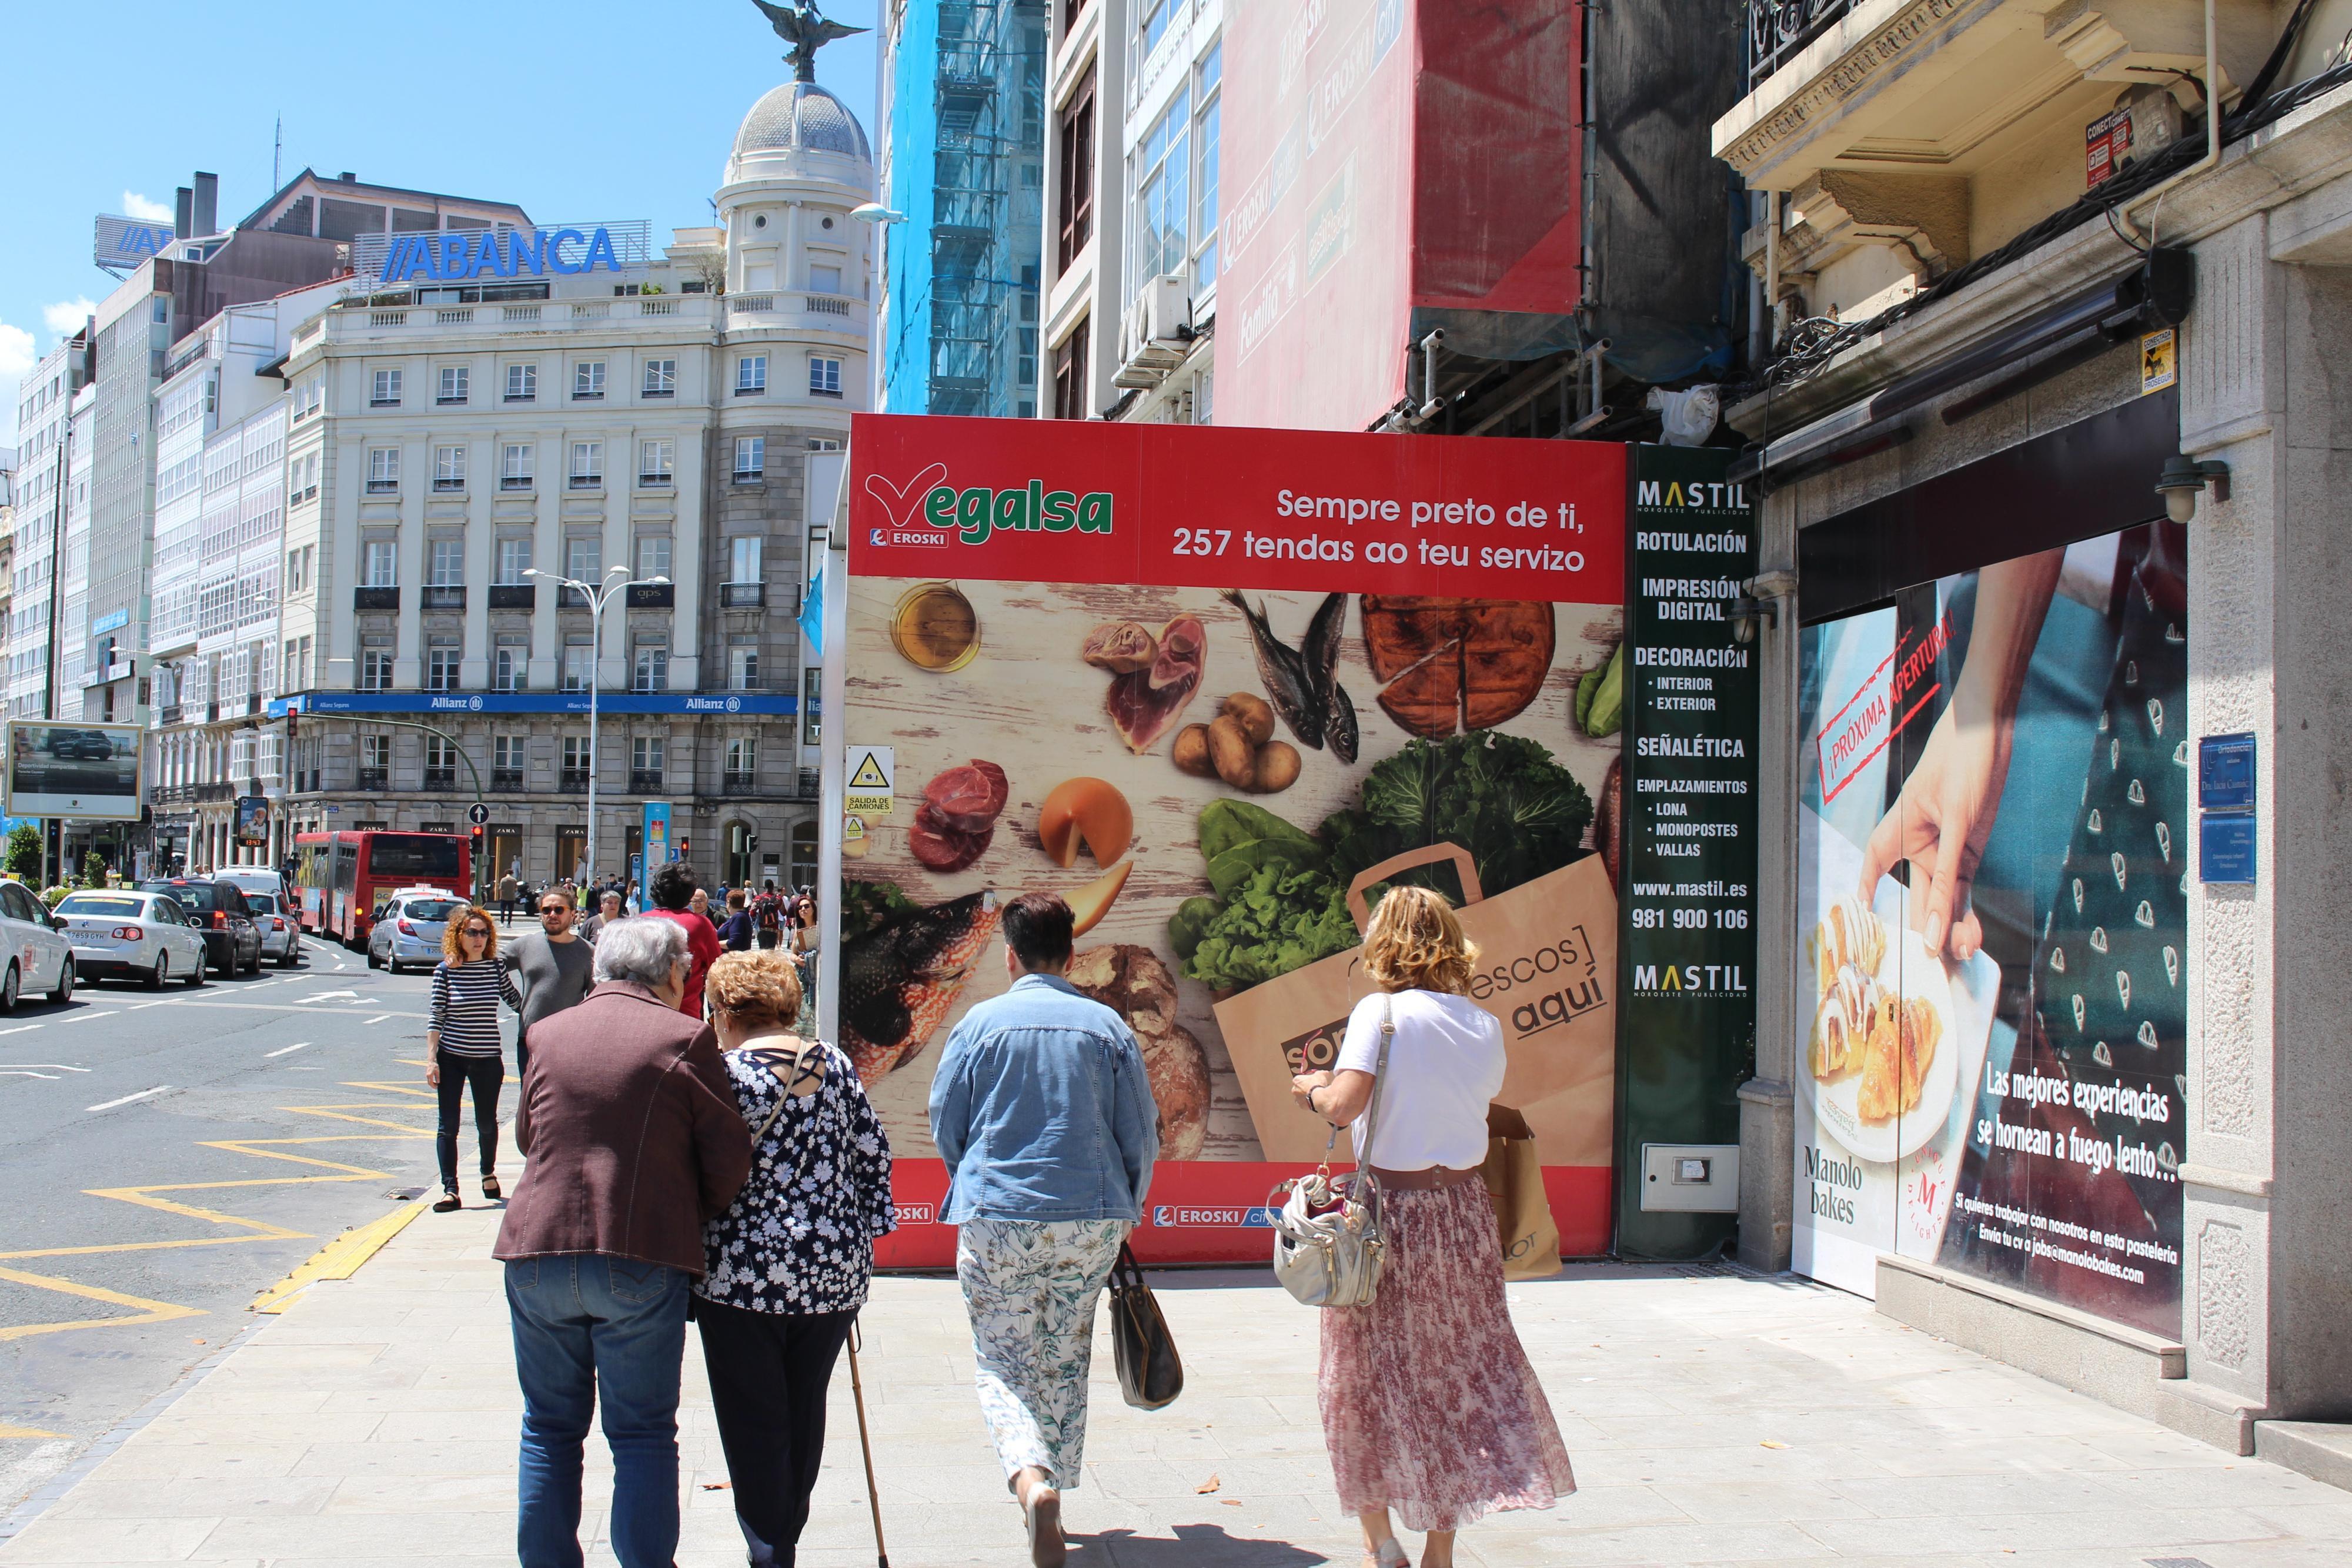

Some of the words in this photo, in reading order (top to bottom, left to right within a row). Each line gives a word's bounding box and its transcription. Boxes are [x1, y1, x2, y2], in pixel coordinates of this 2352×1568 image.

[1325, 26, 1369, 121] EROSKI
[2087, 116, 2113, 140] CONECT
[1237, 175, 1269, 245] EROSKI
[402, 228, 622, 281] ABANCA
[2144, 330, 2171, 347] CONECTADA
[2144, 373, 2171, 390] PROSEGUR
[866, 463, 1113, 545] Vegalsa
[1277, 489, 1400, 525] Sempre
[1412, 498, 1495, 528] preto
[1506, 501, 1548, 529] de
[1558, 503, 1584, 534] ti,
[893, 531, 944, 545] EROSKI
[1637, 530, 1746, 553] ROTULACIÓN
[1173, 528, 1231, 556] 257
[1244, 530, 1354, 562] tendas
[1365, 540, 1408, 564] ao
[1418, 539, 1469, 566] teu
[1479, 544, 1585, 572] servizo
[1643, 576, 1740, 599] IMPRESIÓN
[1658, 601, 1725, 621] DIGITAL
[1635, 644, 1748, 668] DECORACIÓN
[1657, 677, 1712, 690] INTERIOR
[1829, 695, 1886, 780] ¡PRÓXIMA
[1889, 609, 1956, 710] APERTURA!
[432, 697, 467, 708] Allianz
[686, 698, 724, 709] Allianz
[1657, 697, 1716, 710] EXTERIOR
[1637, 734, 1745, 757] SEÑALÉTICA
[1637, 780, 1747, 794] EMPLAZAMIENTOS
[1656, 803, 1688, 815] LONA
[1656, 824, 1738, 837] MONOPOSTES
[1656, 844, 1700, 856] VALLAS
[1633, 881, 1748, 897] www.mastil.es
[1632, 909, 1664, 928] 981
[1673, 909, 1708, 928] 900
[1713, 910, 1748, 929] 106
[1471, 925, 1595, 999] escos]
[1512, 965, 1603, 1032] aquí
[1986, 1061, 2009, 1096] Las
[2013, 1066, 2069, 1109] mejores
[2073, 1078, 2169, 1123] experiencias
[1977, 1118, 1992, 1146] se
[1996, 1114, 2050, 1156] hornean
[2055, 1132, 2065, 1159] a
[2069, 1126, 2112, 1175] fuego
[2117, 1135, 2176, 1183] lento...
[1804, 1145, 1862, 1191] Manolo
[894, 1208, 928, 1220] OSKI
[1810, 1181, 1854, 1225] bakes
[1907, 1183, 1942, 1240] DELIGHTS
[1180, 1211, 1238, 1223] EROSKI
[1955, 1192, 1963, 1209] Si
[1964, 1196, 1993, 1217] quieres
[1995, 1202, 2028, 1228] trabajar
[2030, 1213, 2047, 1229] con
[2049, 1216, 2088, 1241] nosotros
[2090, 1229, 2102, 1245] en
[2104, 1233, 2125, 1251] esta
[2002, 1231, 2012, 1247] tu
[2013, 1236, 2023, 1250] cv
[2024, 1239, 2031, 1252] a
[2032, 1236, 2144, 1285] jobs@manolobakes.com
